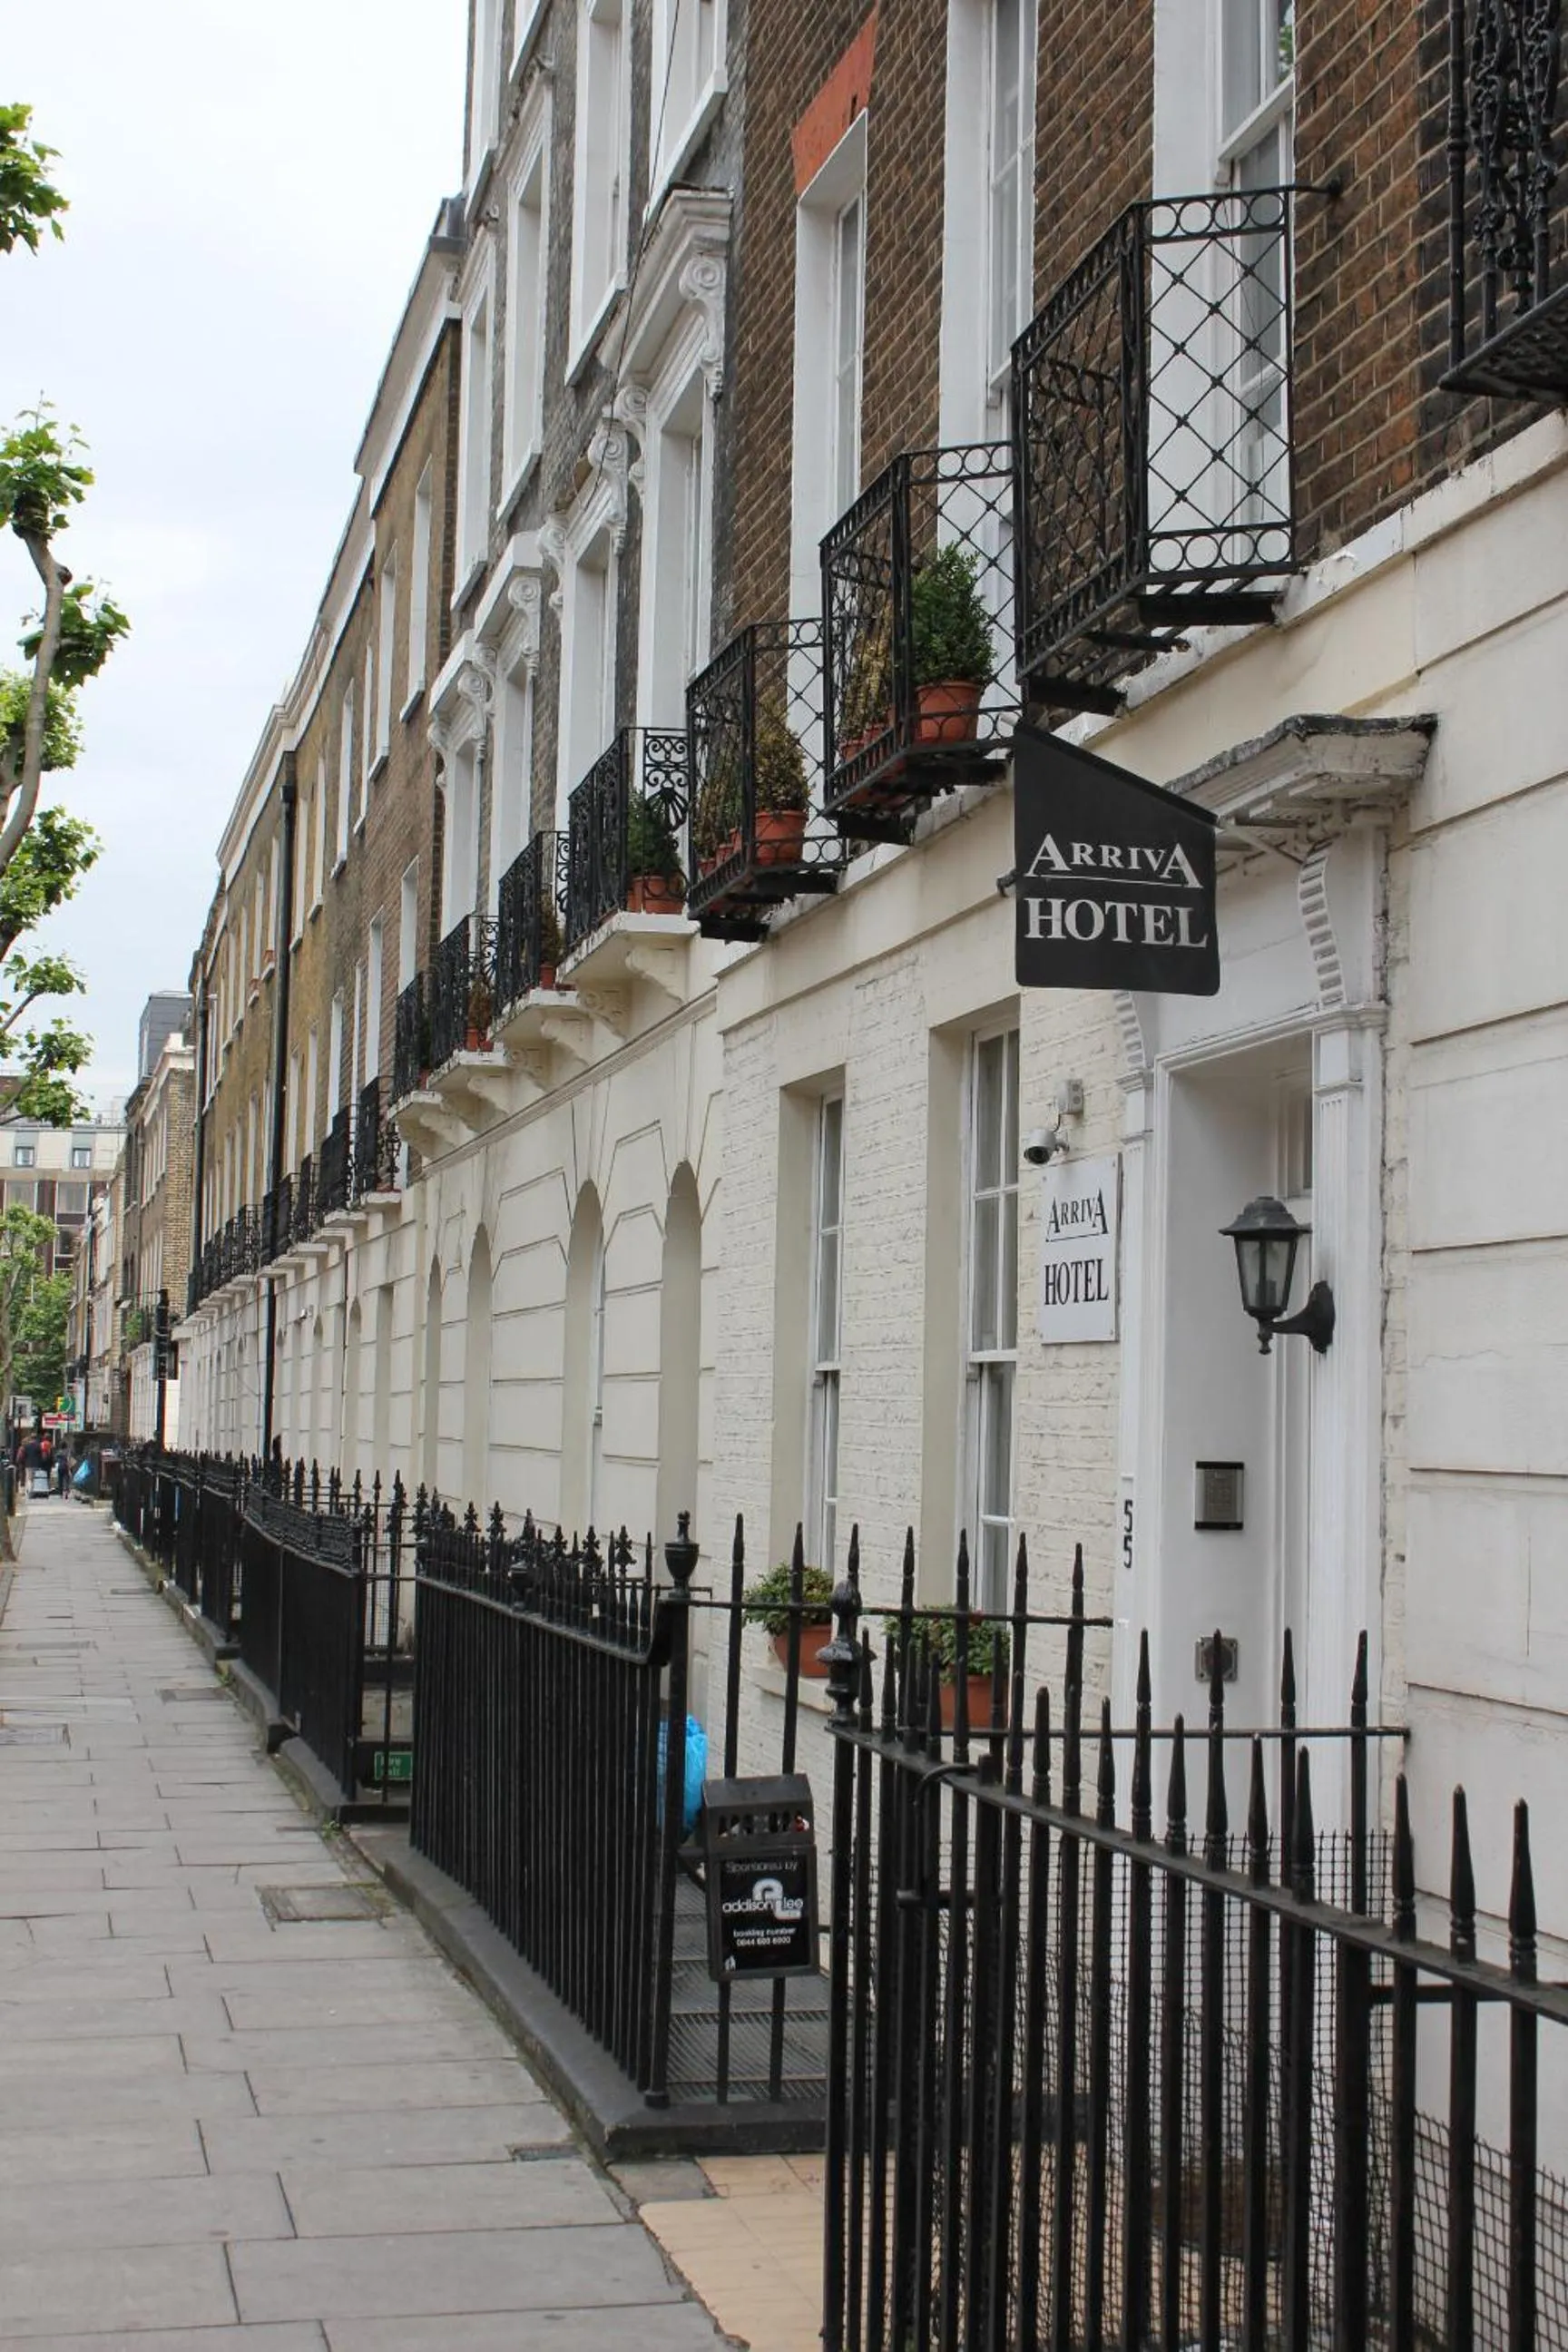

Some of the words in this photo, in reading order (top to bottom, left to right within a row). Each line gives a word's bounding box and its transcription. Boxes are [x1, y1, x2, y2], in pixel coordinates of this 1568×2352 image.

[1024, 833, 1204, 888] ARRIVA
[1024, 897, 1208, 948] HOTEL
[1045, 1188, 1109, 1242] ARRIVA
[1044, 1259, 1110, 1306] HOTEL
[722, 1897, 773, 1913] addison
